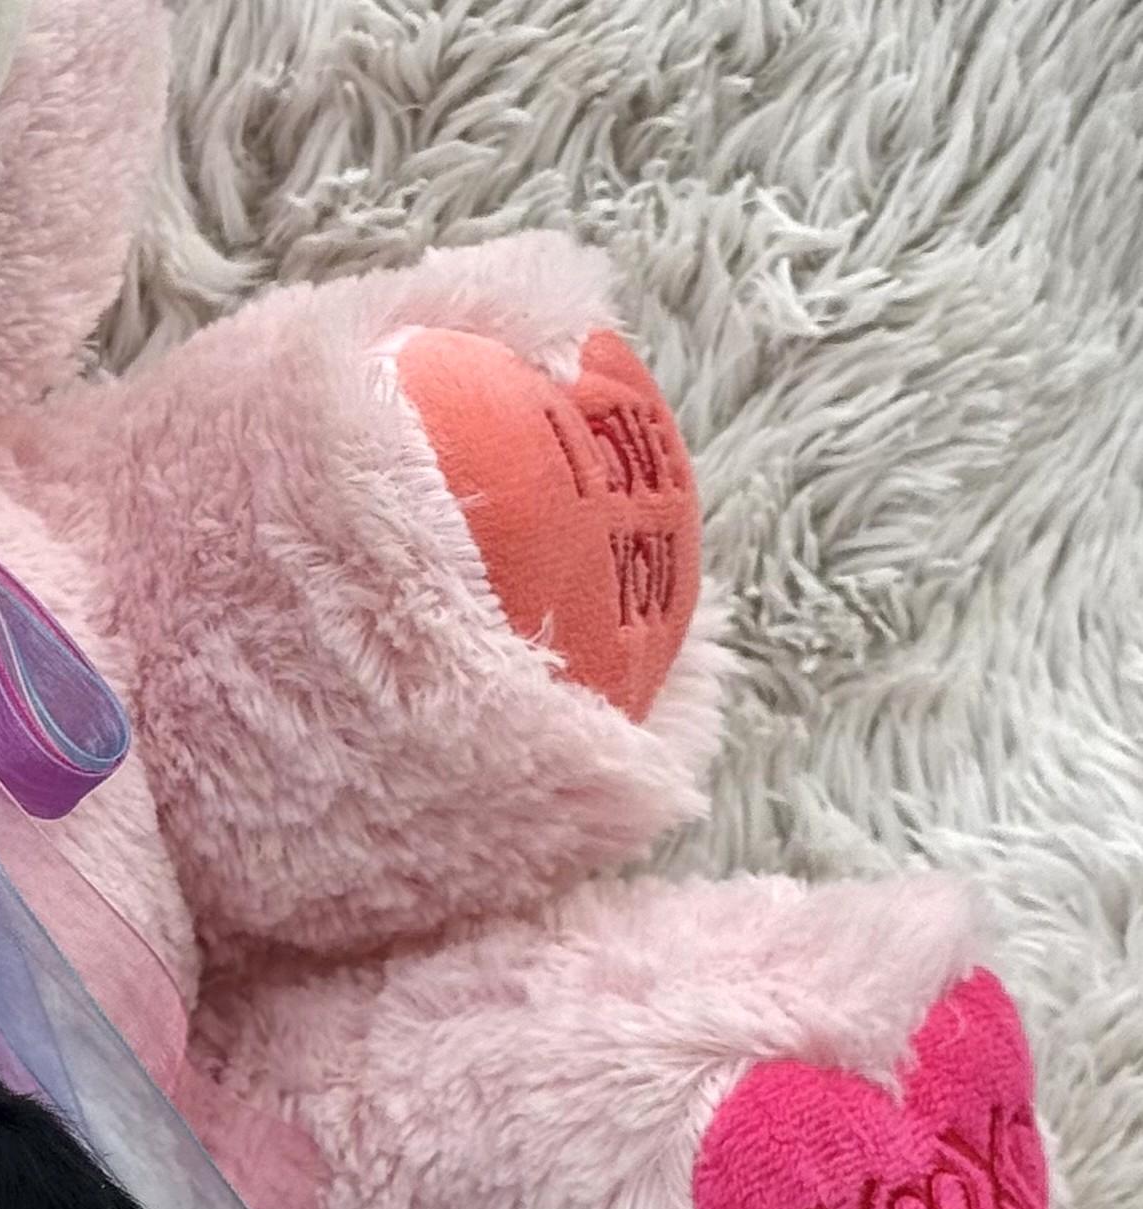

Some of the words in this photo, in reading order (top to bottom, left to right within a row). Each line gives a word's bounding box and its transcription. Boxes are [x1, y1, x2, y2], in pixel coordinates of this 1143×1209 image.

[543, 407, 586, 499] I
[573, 402, 686, 497] OVE
[608, 531, 677, 627] YOU
